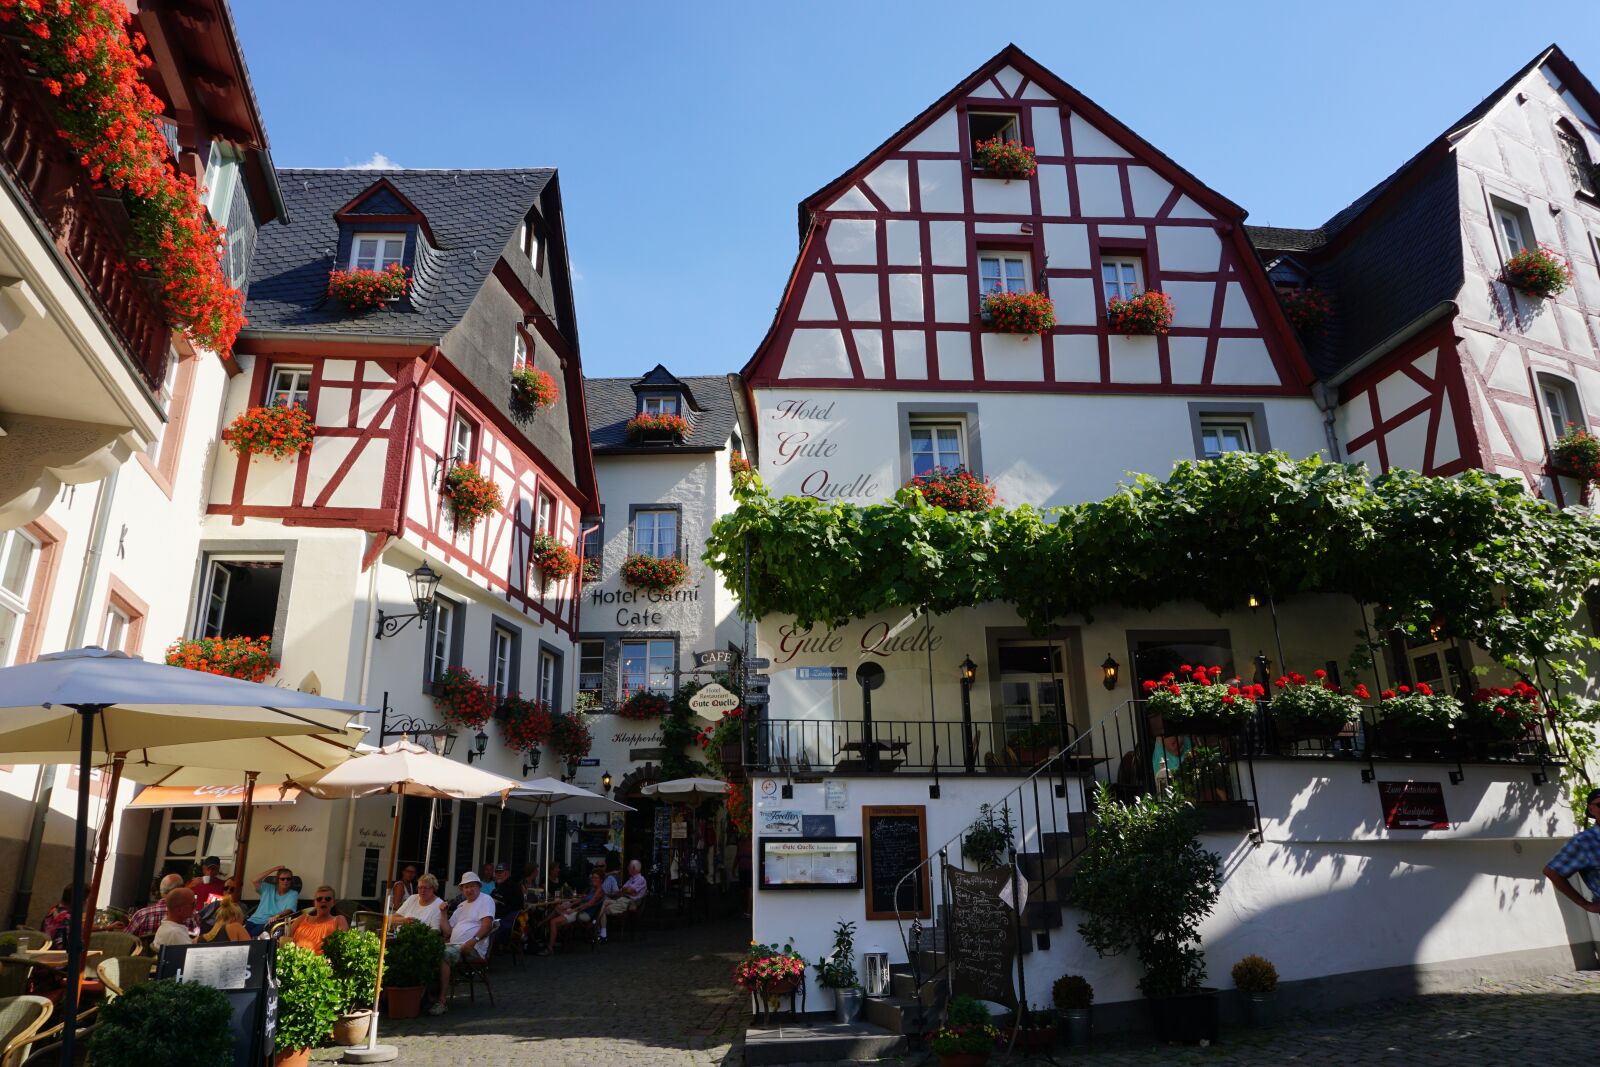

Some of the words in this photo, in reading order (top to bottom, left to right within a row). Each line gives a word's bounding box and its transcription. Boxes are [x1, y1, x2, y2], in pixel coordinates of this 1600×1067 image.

[772, 398, 836, 421] Hotel
[773, 431, 838, 466] Gute
[800, 469, 879, 502] Quelle
[592, 588, 637, 607] Hotel
[647, 586, 700, 603] Garni
[616, 607, 662, 627] Cafe
[774, 624, 844, 664] Gute
[860, 621, 944, 657] Quelle
[701, 651, 732, 664] CAFE
[711, 699, 737, 707] Quelle
